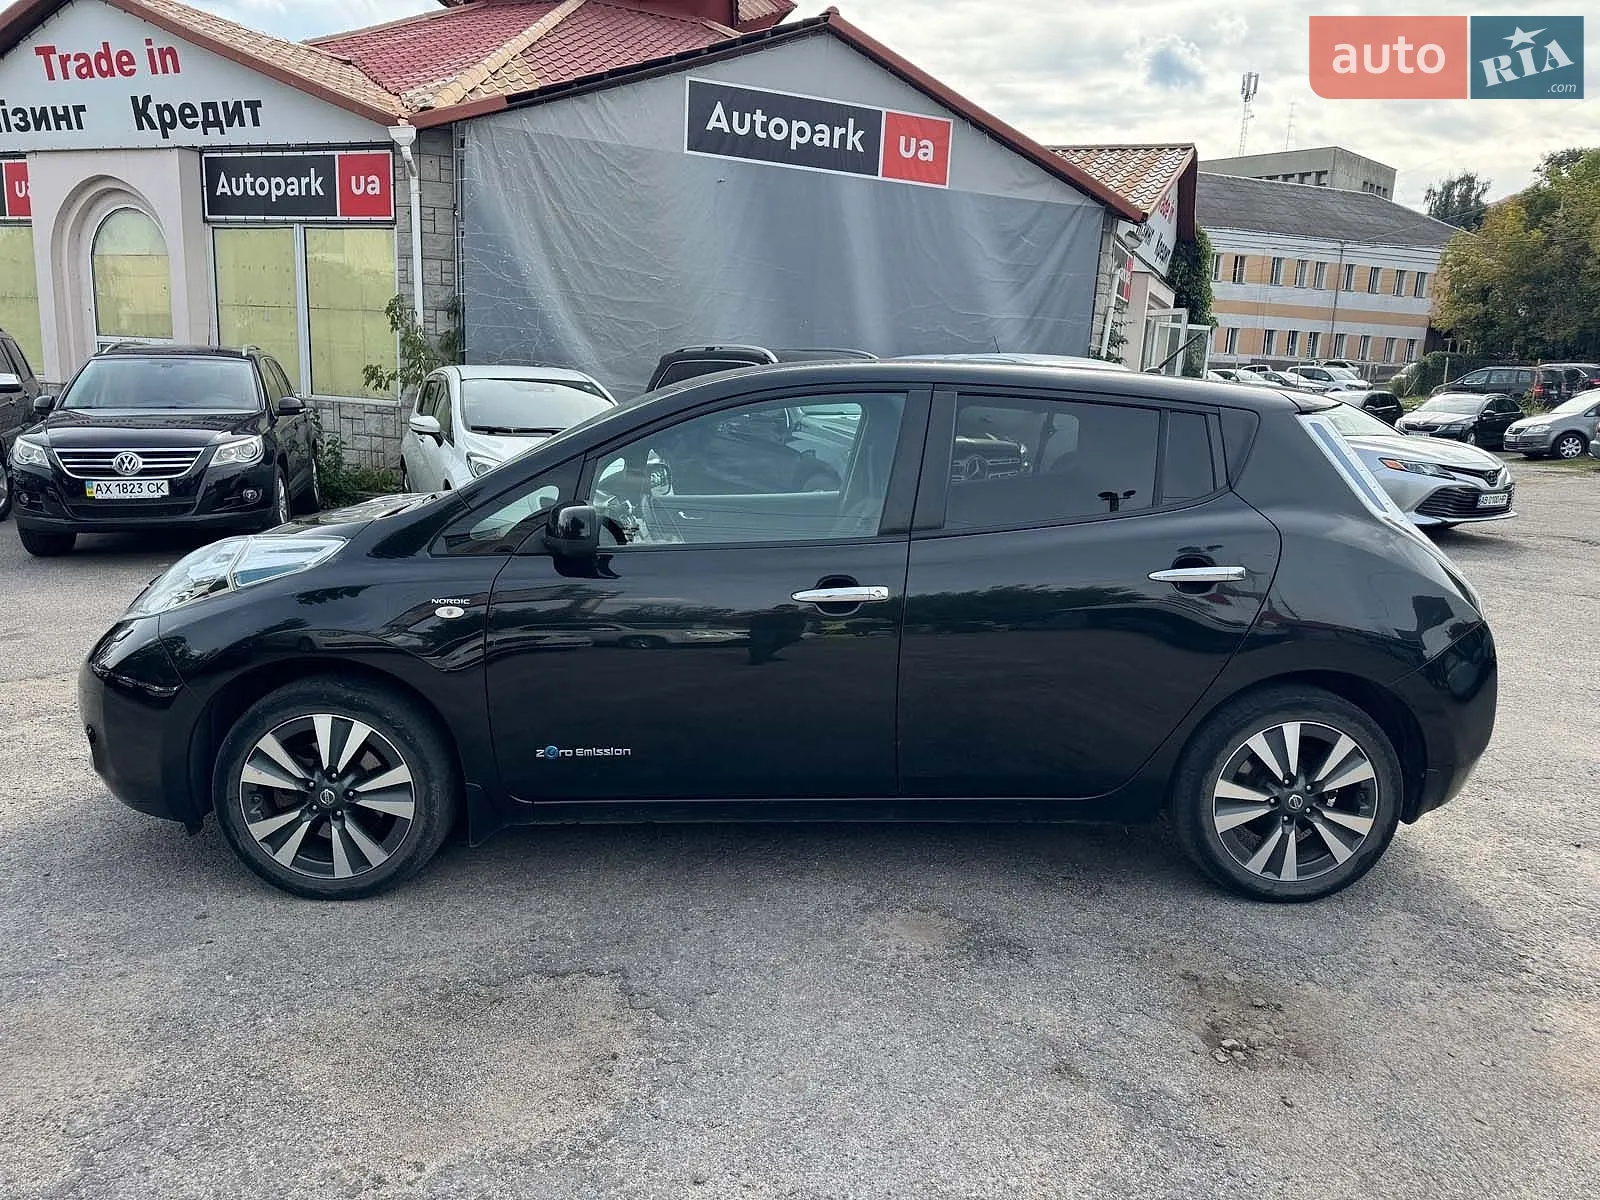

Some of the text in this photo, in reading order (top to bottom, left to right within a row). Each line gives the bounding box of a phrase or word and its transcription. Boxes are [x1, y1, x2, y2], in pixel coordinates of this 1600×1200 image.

[35, 38, 182, 81] Trade in
[0, 98, 87, 133] ізинг
[130, 95, 263, 139] Кредит
[705, 100, 935, 162] Autopark ua
[215, 168, 381, 201] Autopark ua
[95, 482, 166, 494] AX 1823 CK
